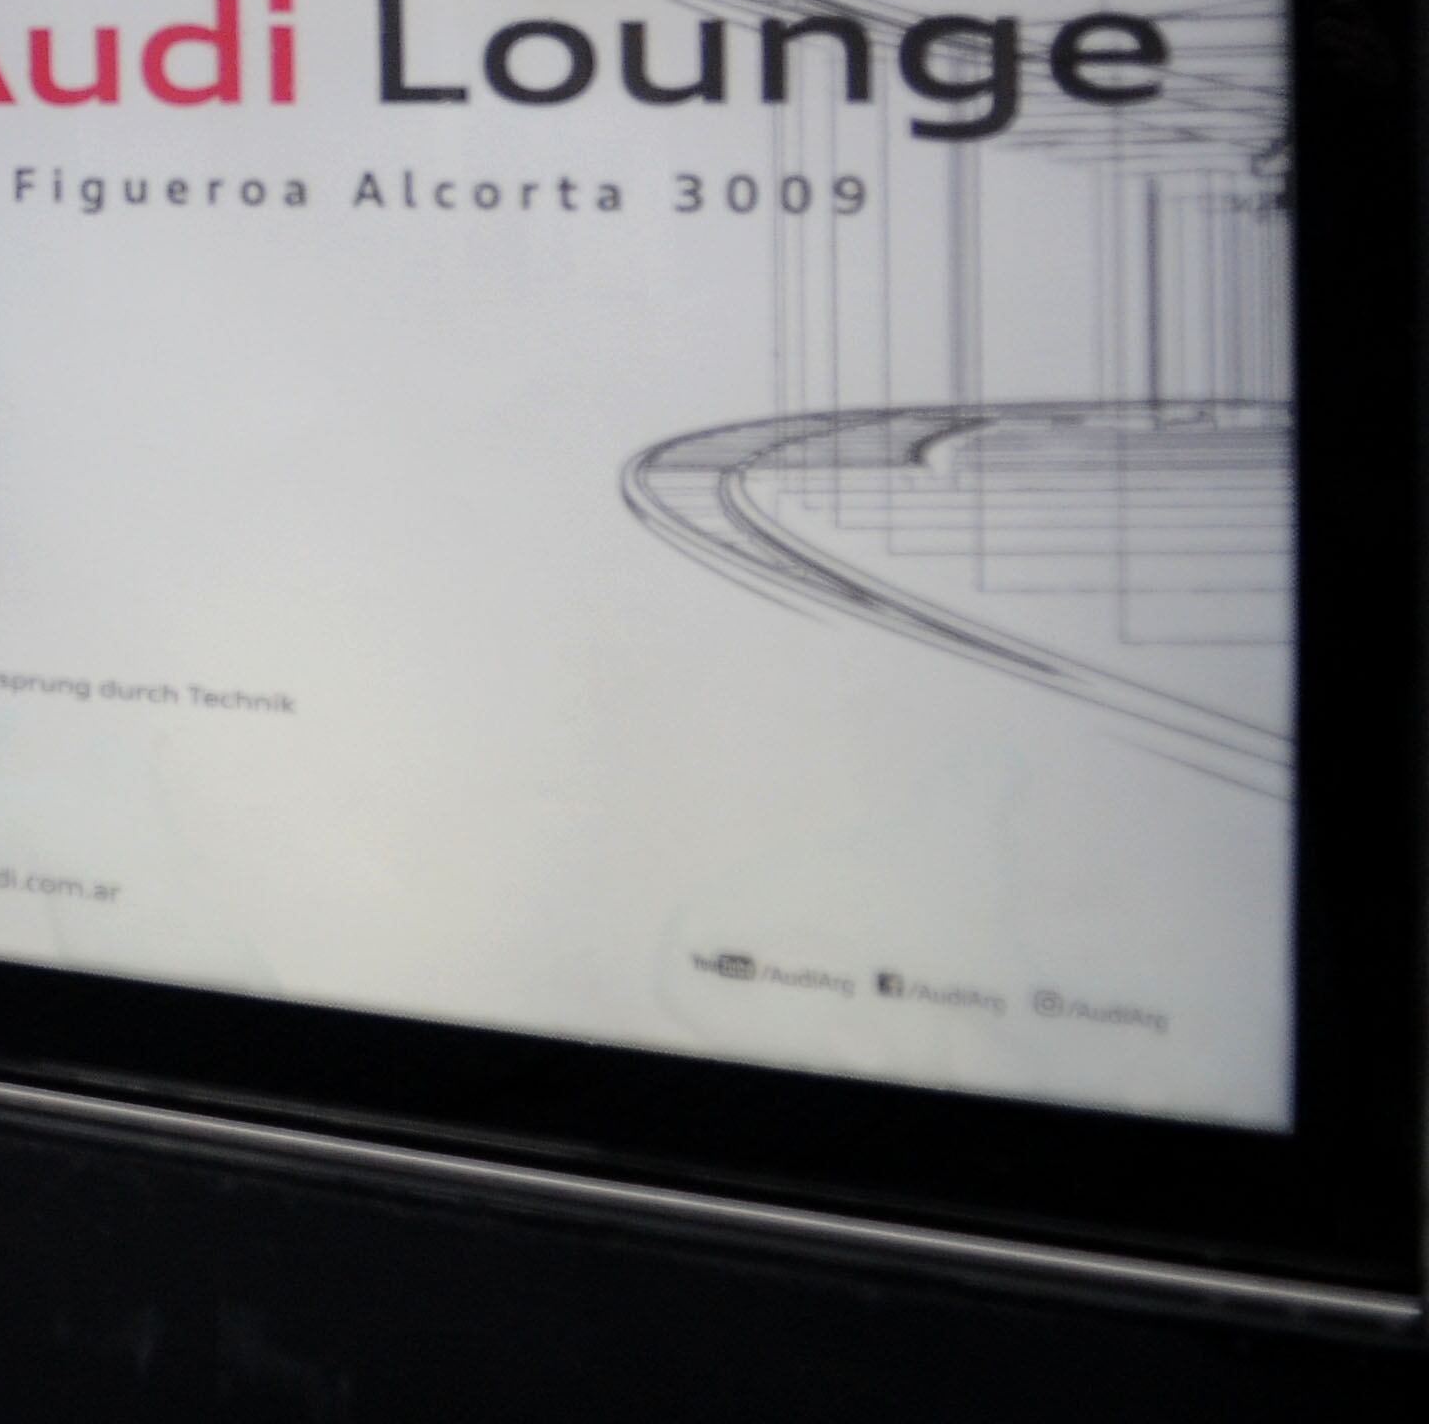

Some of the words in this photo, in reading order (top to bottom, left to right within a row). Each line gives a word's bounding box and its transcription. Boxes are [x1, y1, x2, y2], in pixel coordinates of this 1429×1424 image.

[14, 168, 308, 213] Figueroa
[353, 171, 623, 210] Alcorta
[673, 174, 867, 214] 3009
[100, 680, 179, 705] durch
[189, 686, 296, 714] Technik
